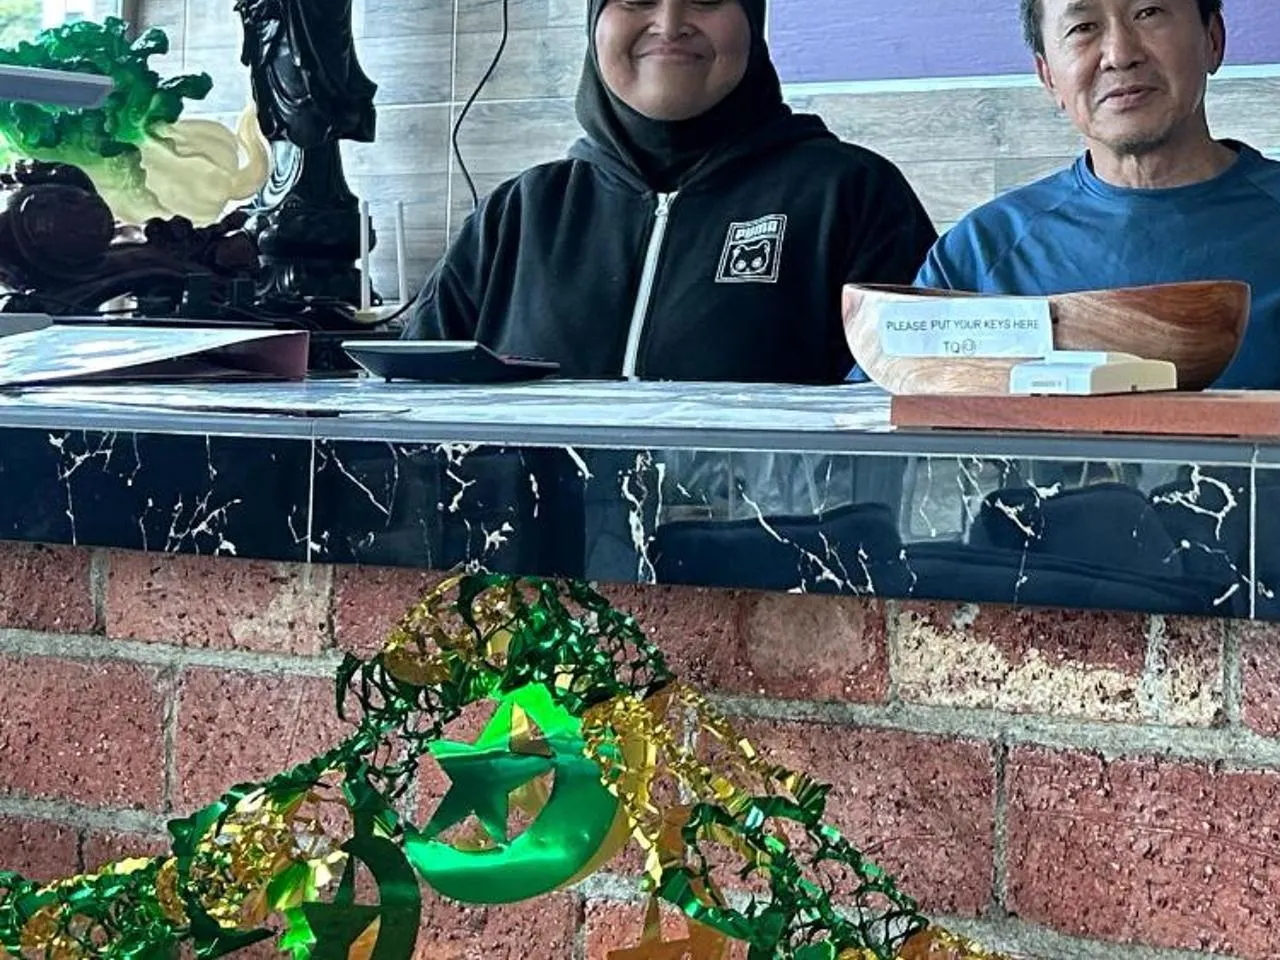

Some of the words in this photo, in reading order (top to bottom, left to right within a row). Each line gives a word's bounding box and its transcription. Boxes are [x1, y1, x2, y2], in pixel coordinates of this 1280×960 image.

[735, 221, 778, 239] PUMA
[886, 320, 928, 332] PLEASE
[930, 319, 951, 330] PUT
[953, 319, 981, 330] YOUR
[983, 319, 1011, 330] KEYS
[1013, 319, 1039, 330] HERE
[943, 341, 960, 354] TQ
